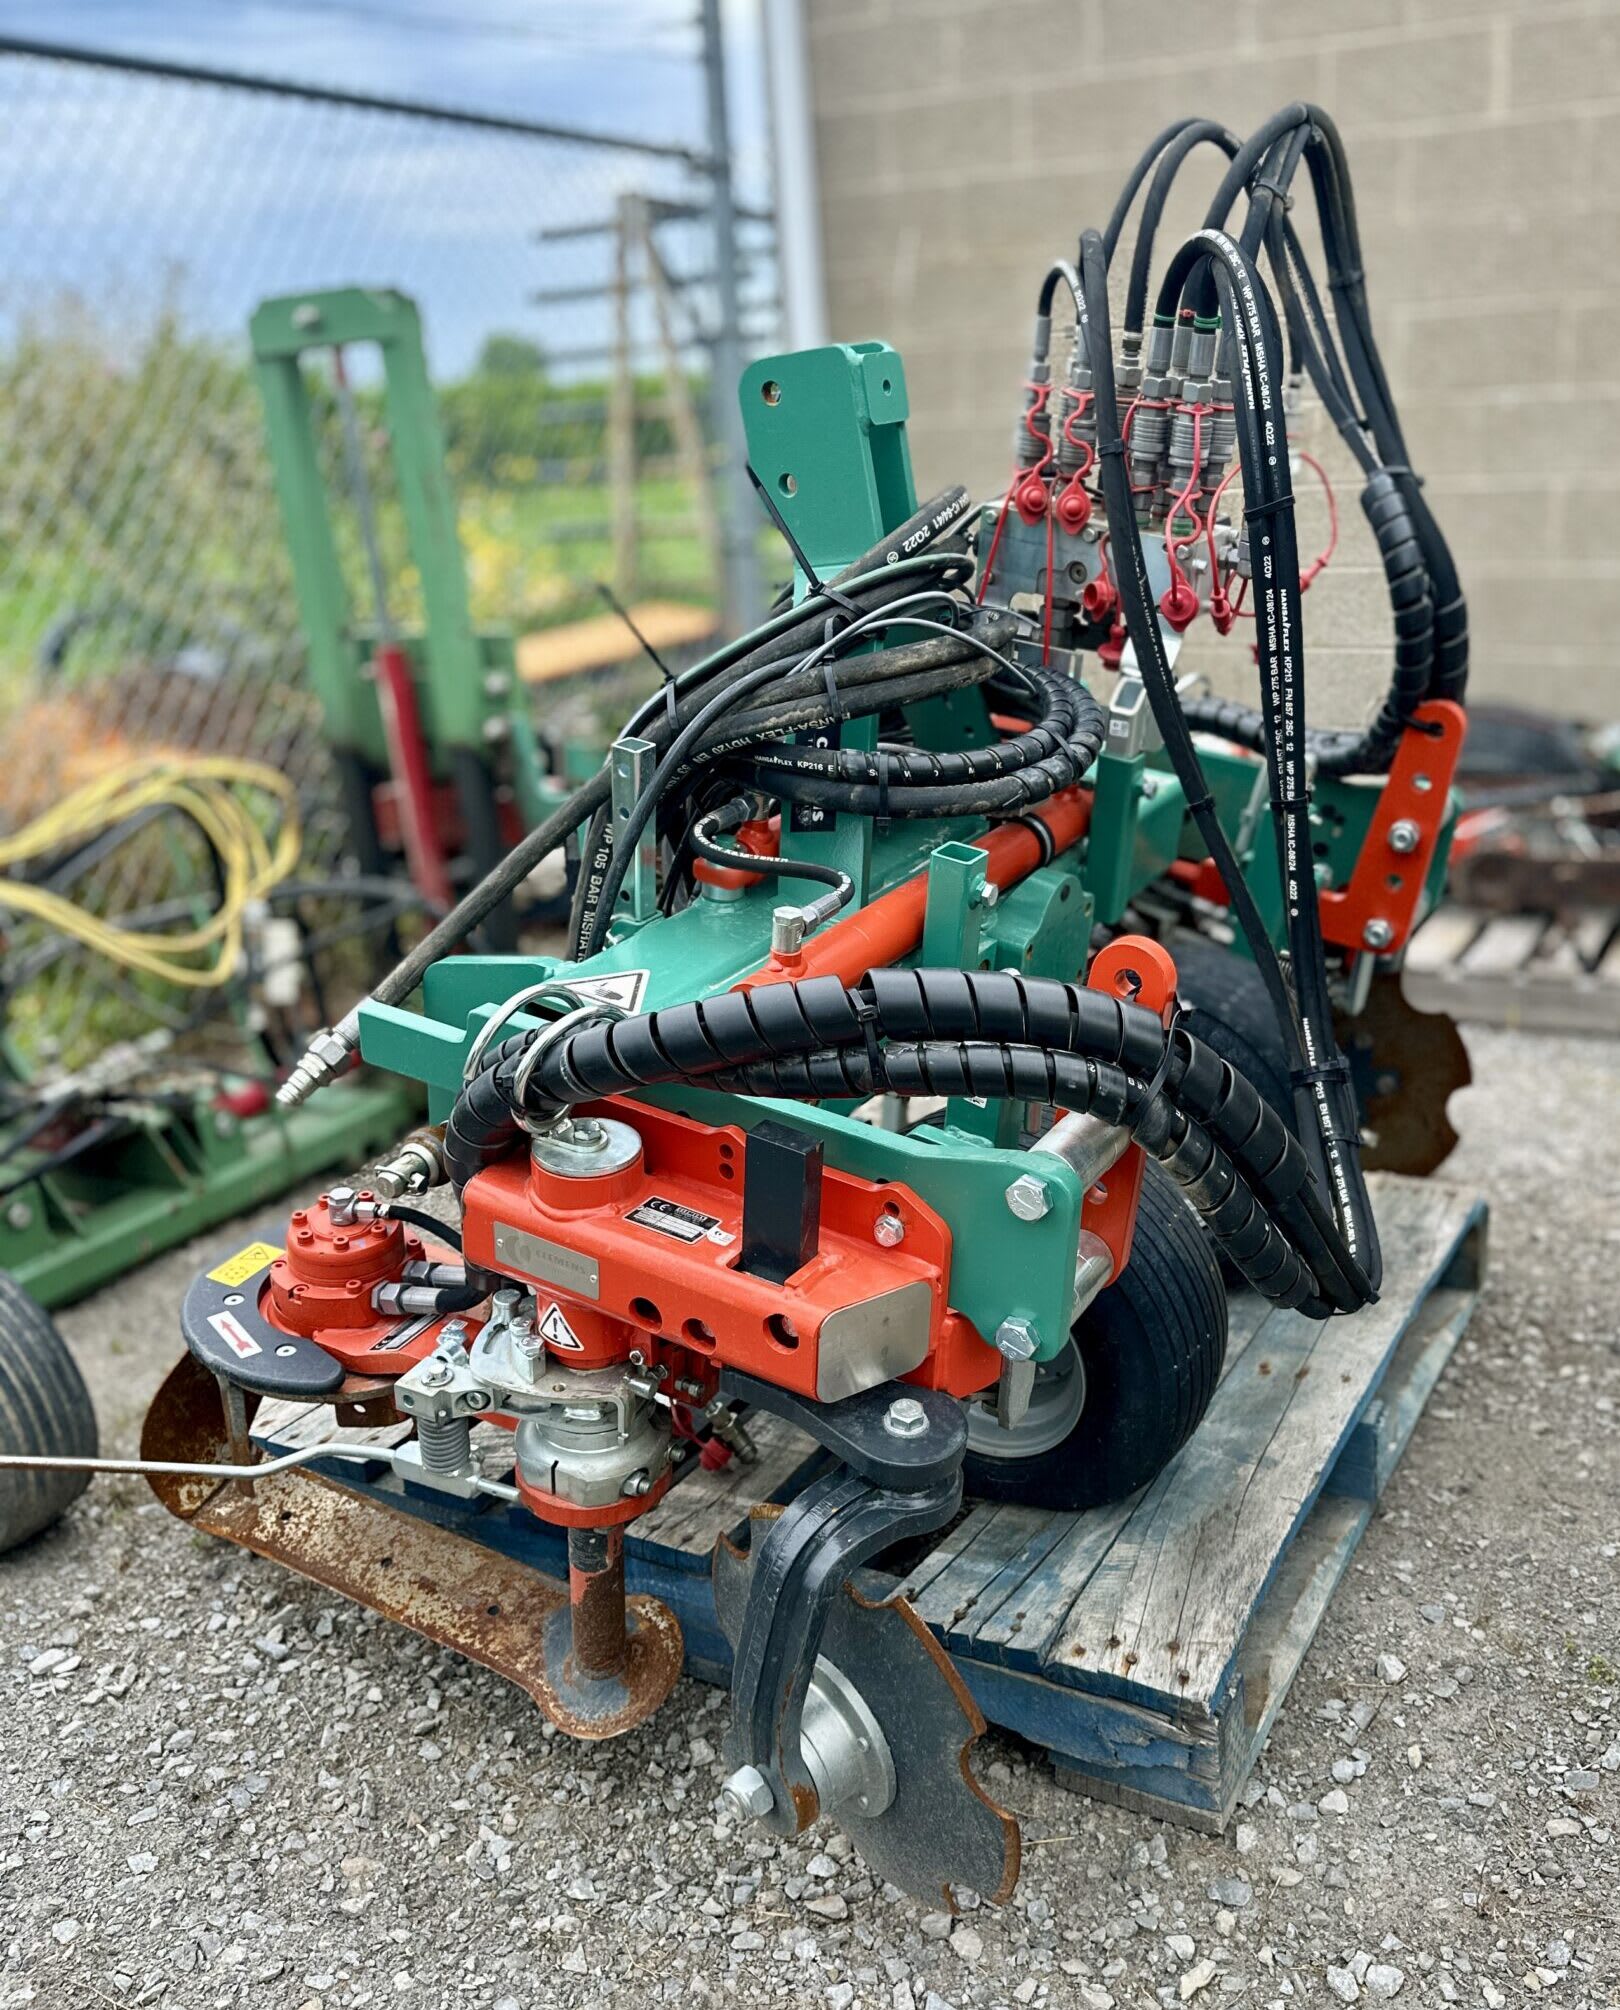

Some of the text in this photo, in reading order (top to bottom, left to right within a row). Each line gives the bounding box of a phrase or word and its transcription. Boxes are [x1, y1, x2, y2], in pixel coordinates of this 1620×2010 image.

[1237, 268, 1246, 280] 12
[1242, 284, 1253, 300] WP
[1246, 300, 1257, 317] 275
[1249, 317, 1261, 338] BAR
[1254, 342, 1267, 371] MSHA
[1259, 371, 1272, 411] IC-08/24
[1265, 420, 1275, 446] 4Q22
[902, 524, 931, 553] 2Q22
[1263, 555, 1272, 579] 4Q22
[1265, 588, 1276, 625] IC-08/24
[1268, 624, 1278, 652] MSHA
[1270, 655, 1278, 676] BAR
[1284, 656, 1292, 682] KP213
[1271, 675, 1280, 691] 275
[1272, 691, 1281, 707] WP
[1285, 701, 1294, 717] 857
[1274, 714, 1282, 724] 12
[1285, 720, 1294, 737] 2SC
[711, 736, 752, 755] HD120
[1286, 742, 1294, 752] 12
[692, 752, 711, 764] EN
[797, 760, 824, 771] KP216
[1286, 760, 1295, 775] WP
[1286, 775, 1295, 791] 275
[602, 823, 613, 845] WP
[1287, 814, 1296, 839] MSHA
[594, 847, 609, 870] 105
[1287, 839, 1297, 872] IC-08/24
[586, 875, 603, 905] BAR
[1289, 879, 1299, 900] 4Q22
[578, 910, 596, 950] MSHA
[1314, 1080, 1326, 1100] P213
